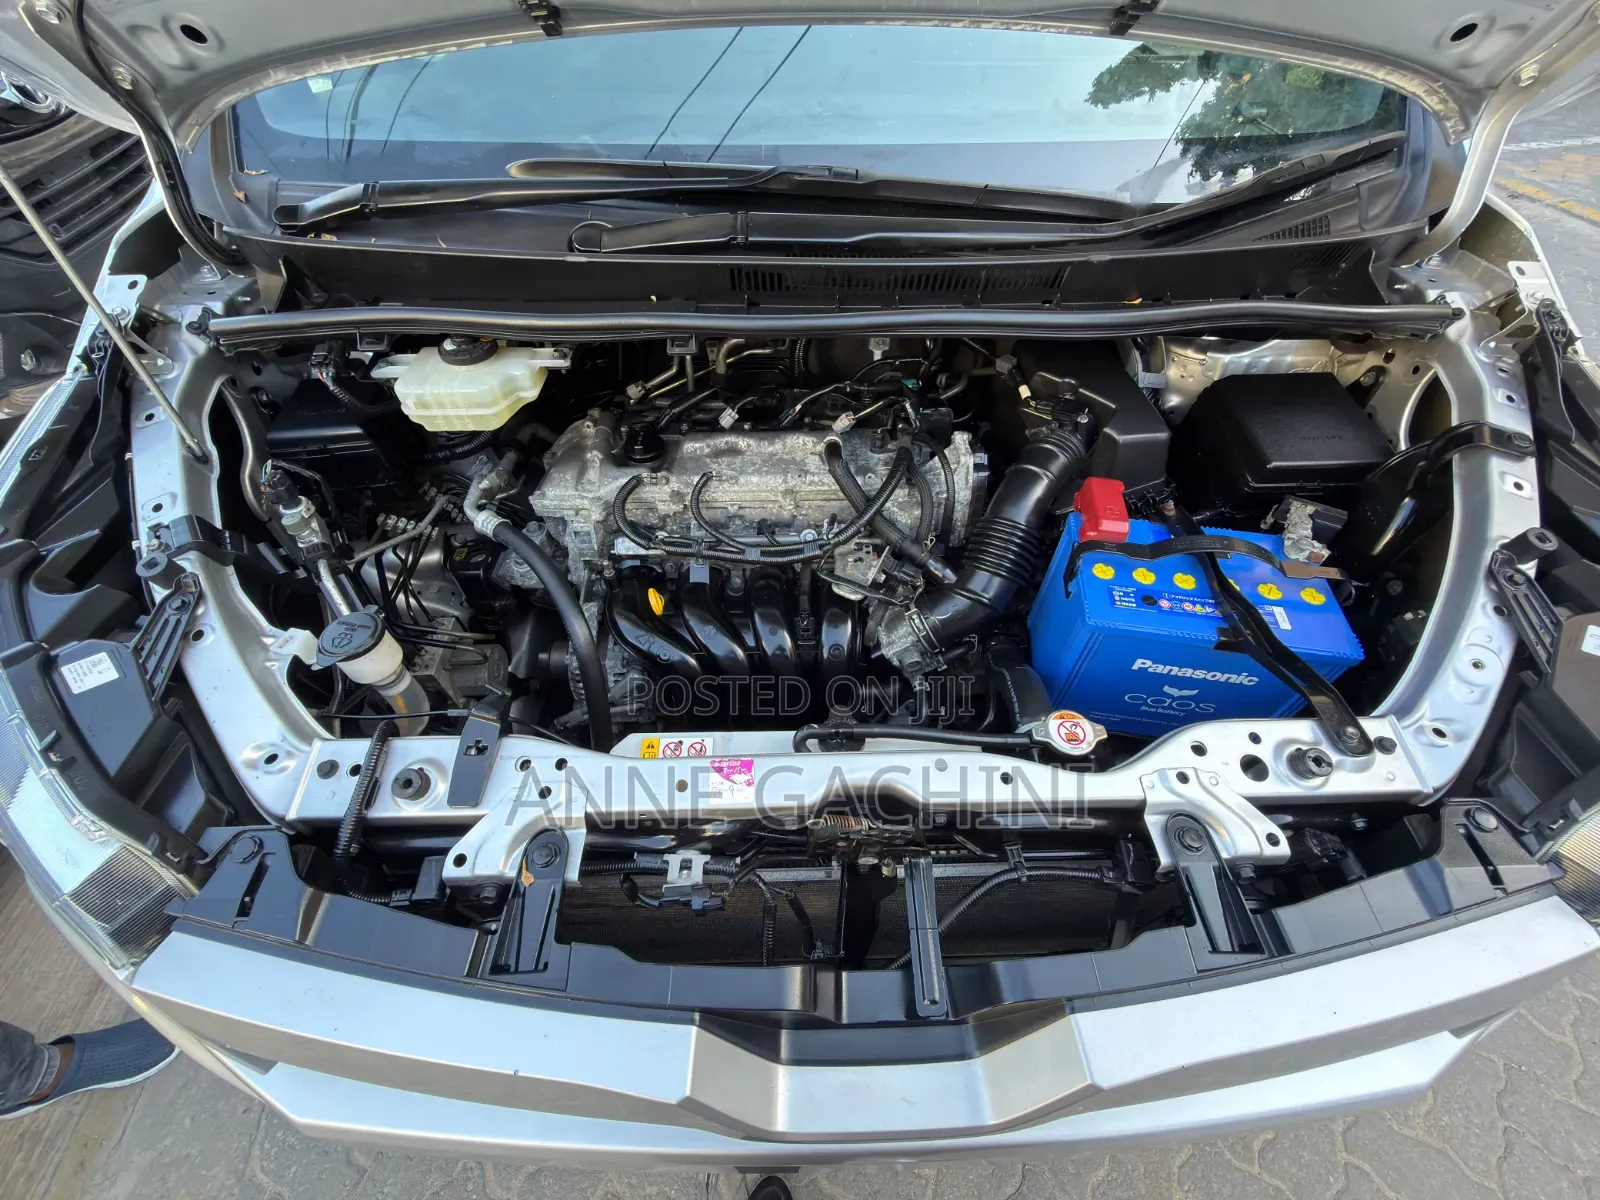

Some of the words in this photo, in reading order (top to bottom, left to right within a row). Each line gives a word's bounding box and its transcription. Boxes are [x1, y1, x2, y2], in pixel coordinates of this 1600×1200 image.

[1131, 658, 1259, 686] Panasonic
[1124, 693, 1217, 713] caos
[1140, 705, 1157, 713] Blue
